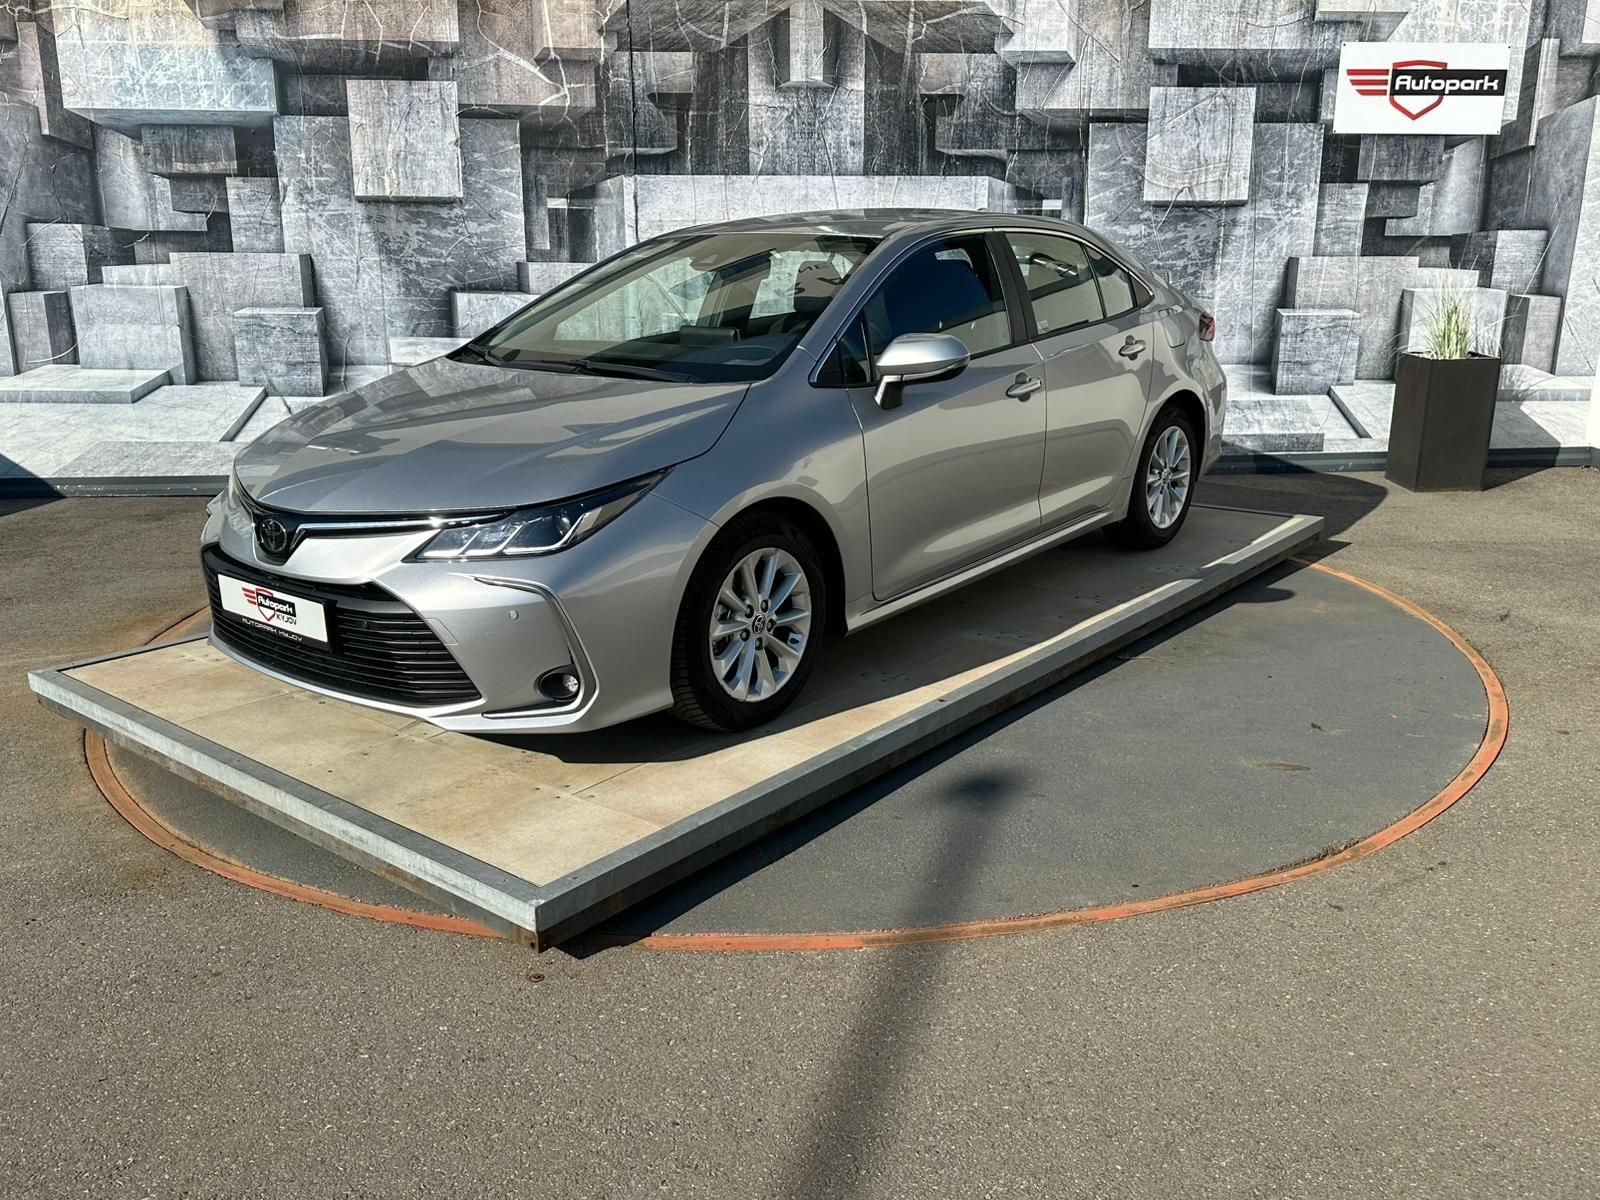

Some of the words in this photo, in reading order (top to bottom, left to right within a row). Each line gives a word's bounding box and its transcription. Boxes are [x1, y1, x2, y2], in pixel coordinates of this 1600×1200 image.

[1394, 75, 1499, 94] Autopark
[257, 595, 294, 614] Autopark
[276, 612, 297, 626] KYJOV
[241, 617, 278, 634] AUTOPARK
[278, 630, 303, 642] KYJOV
